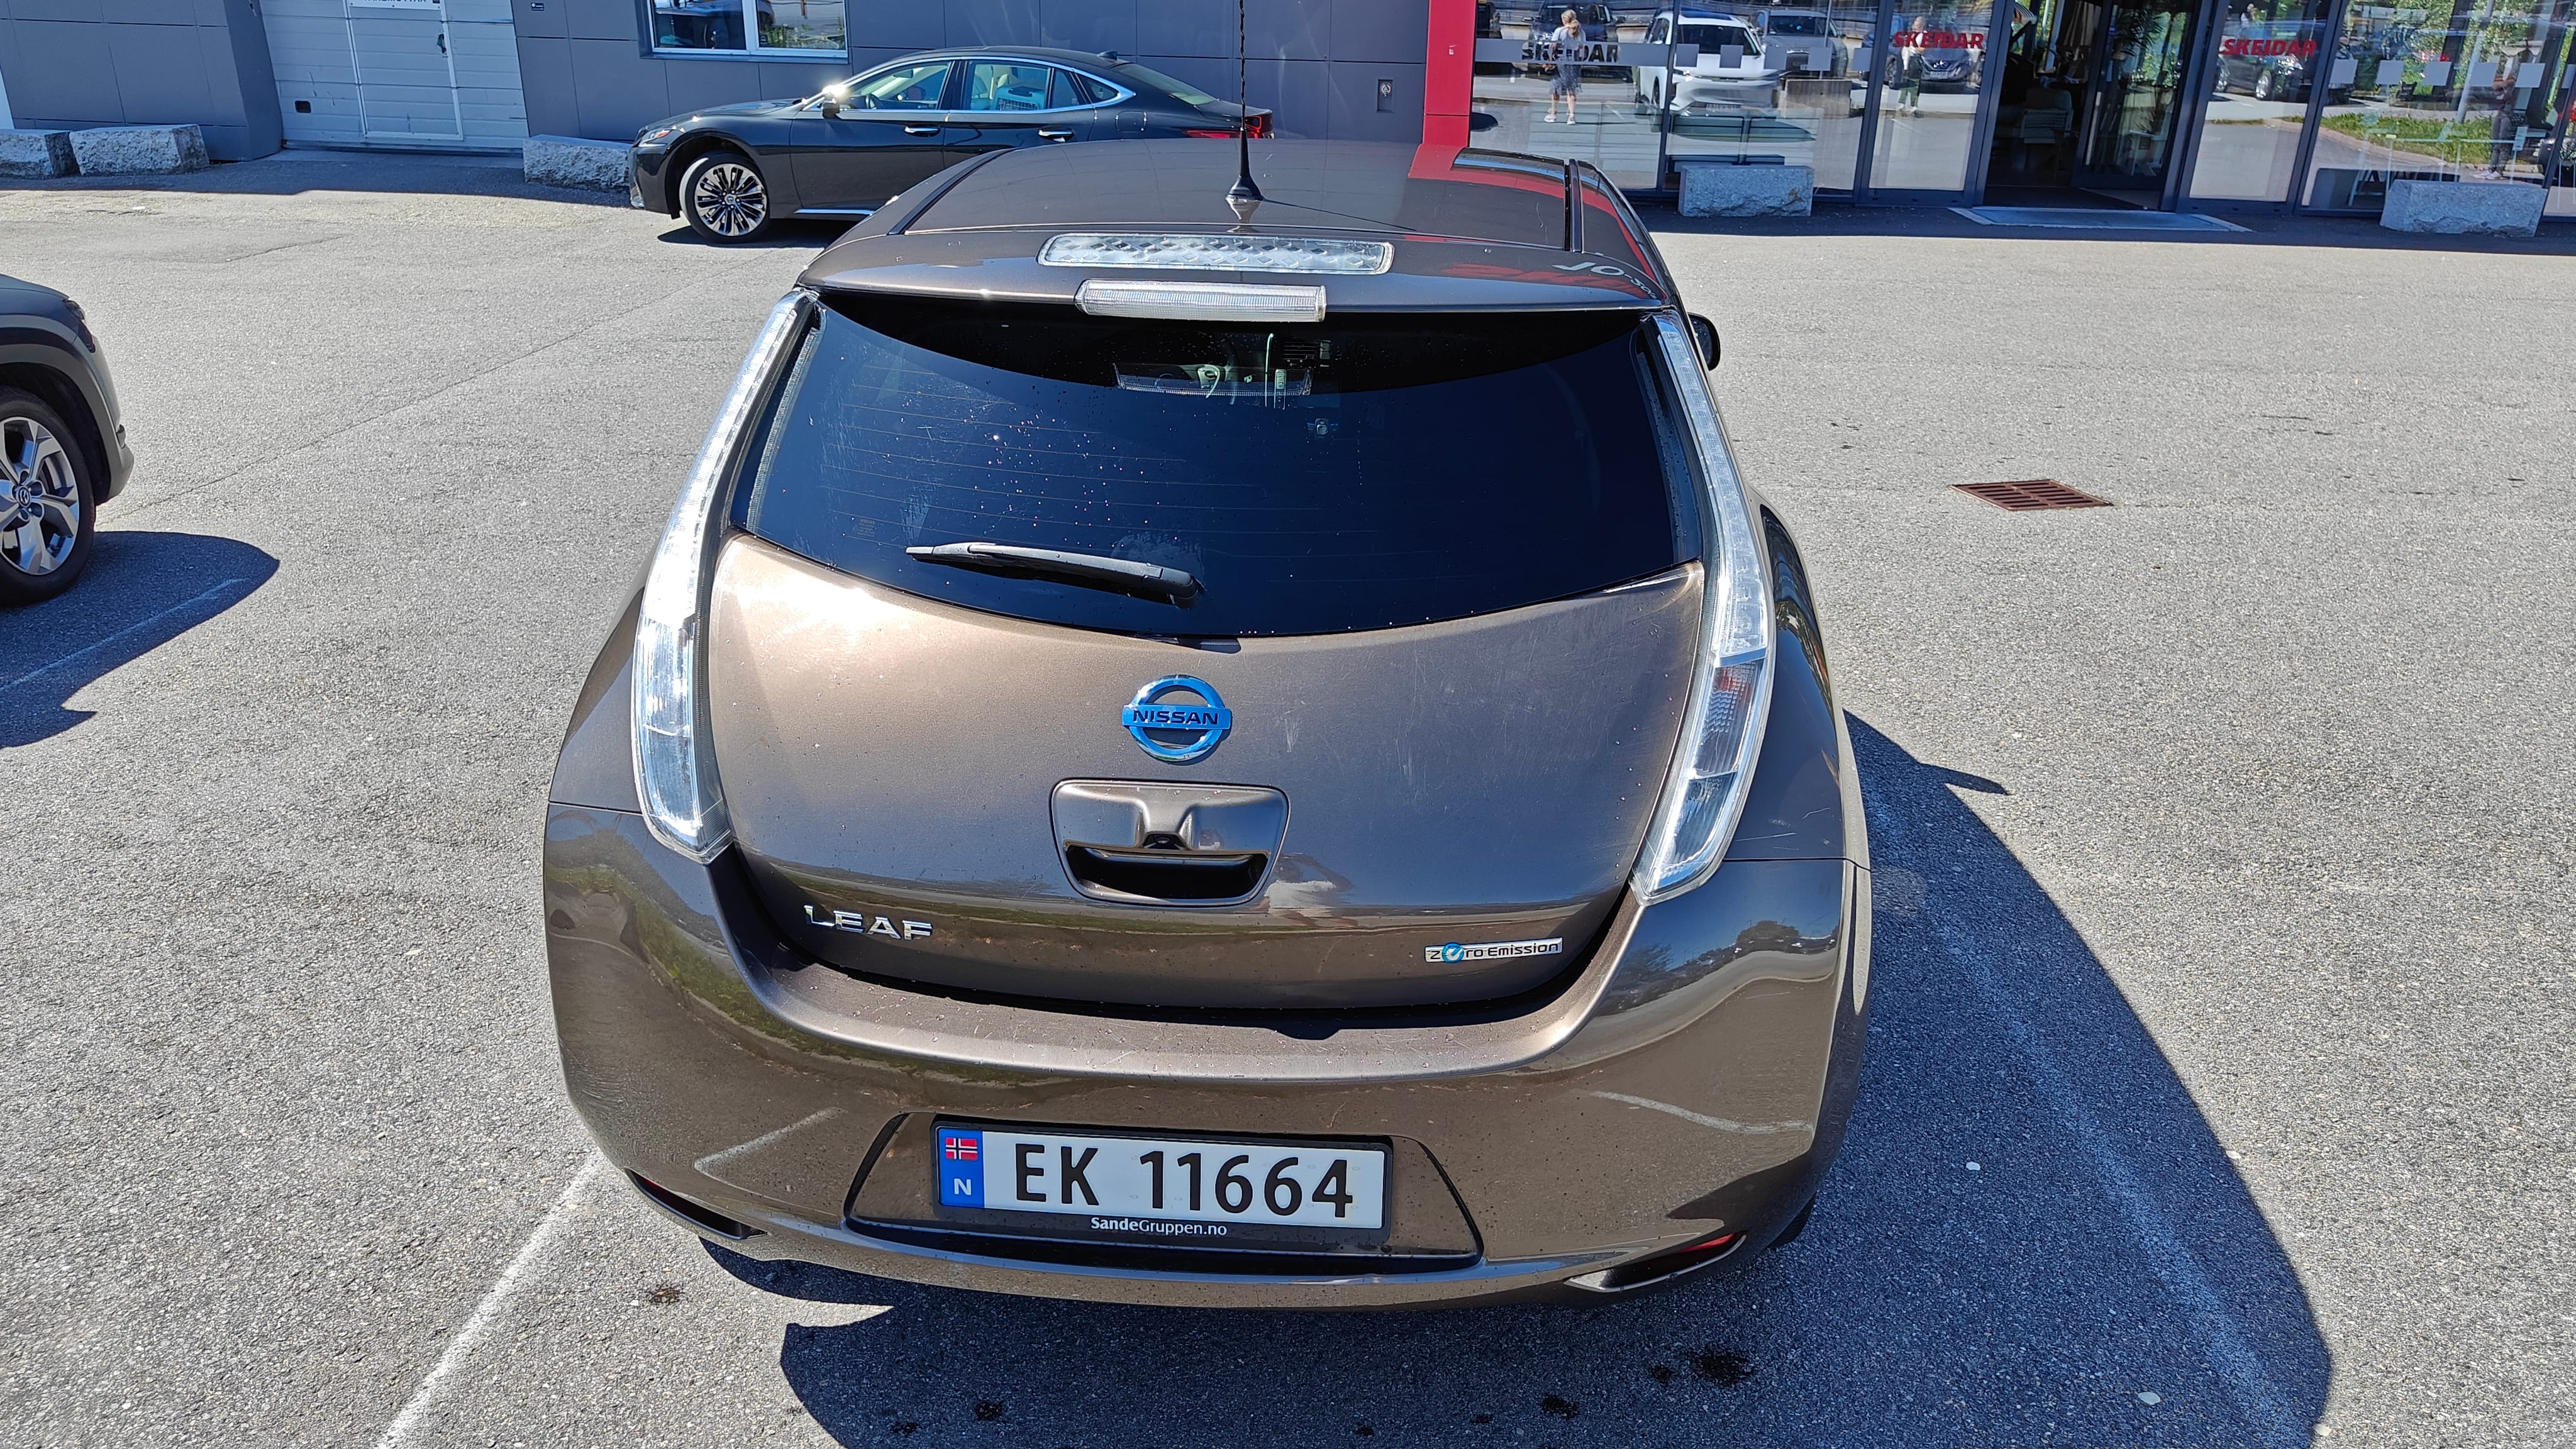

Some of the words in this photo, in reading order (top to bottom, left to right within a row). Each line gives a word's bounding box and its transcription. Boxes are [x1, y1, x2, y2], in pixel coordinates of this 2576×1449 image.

[1892, 31, 1984, 49] SKEIDAR
[2223, 38, 2317, 57] SKEIDAR
[1133, 709, 1218, 725] NISSAN
[803, 904, 933, 941] LEAF
[1487, 943, 1559, 957] Emission
[953, 1178, 972, 1196] N
[1015, 1143, 1100, 1206] EK
[1139, 1150, 1353, 1218] 11664
[1091, 1217, 1228, 1236] SandeGruppen.no
